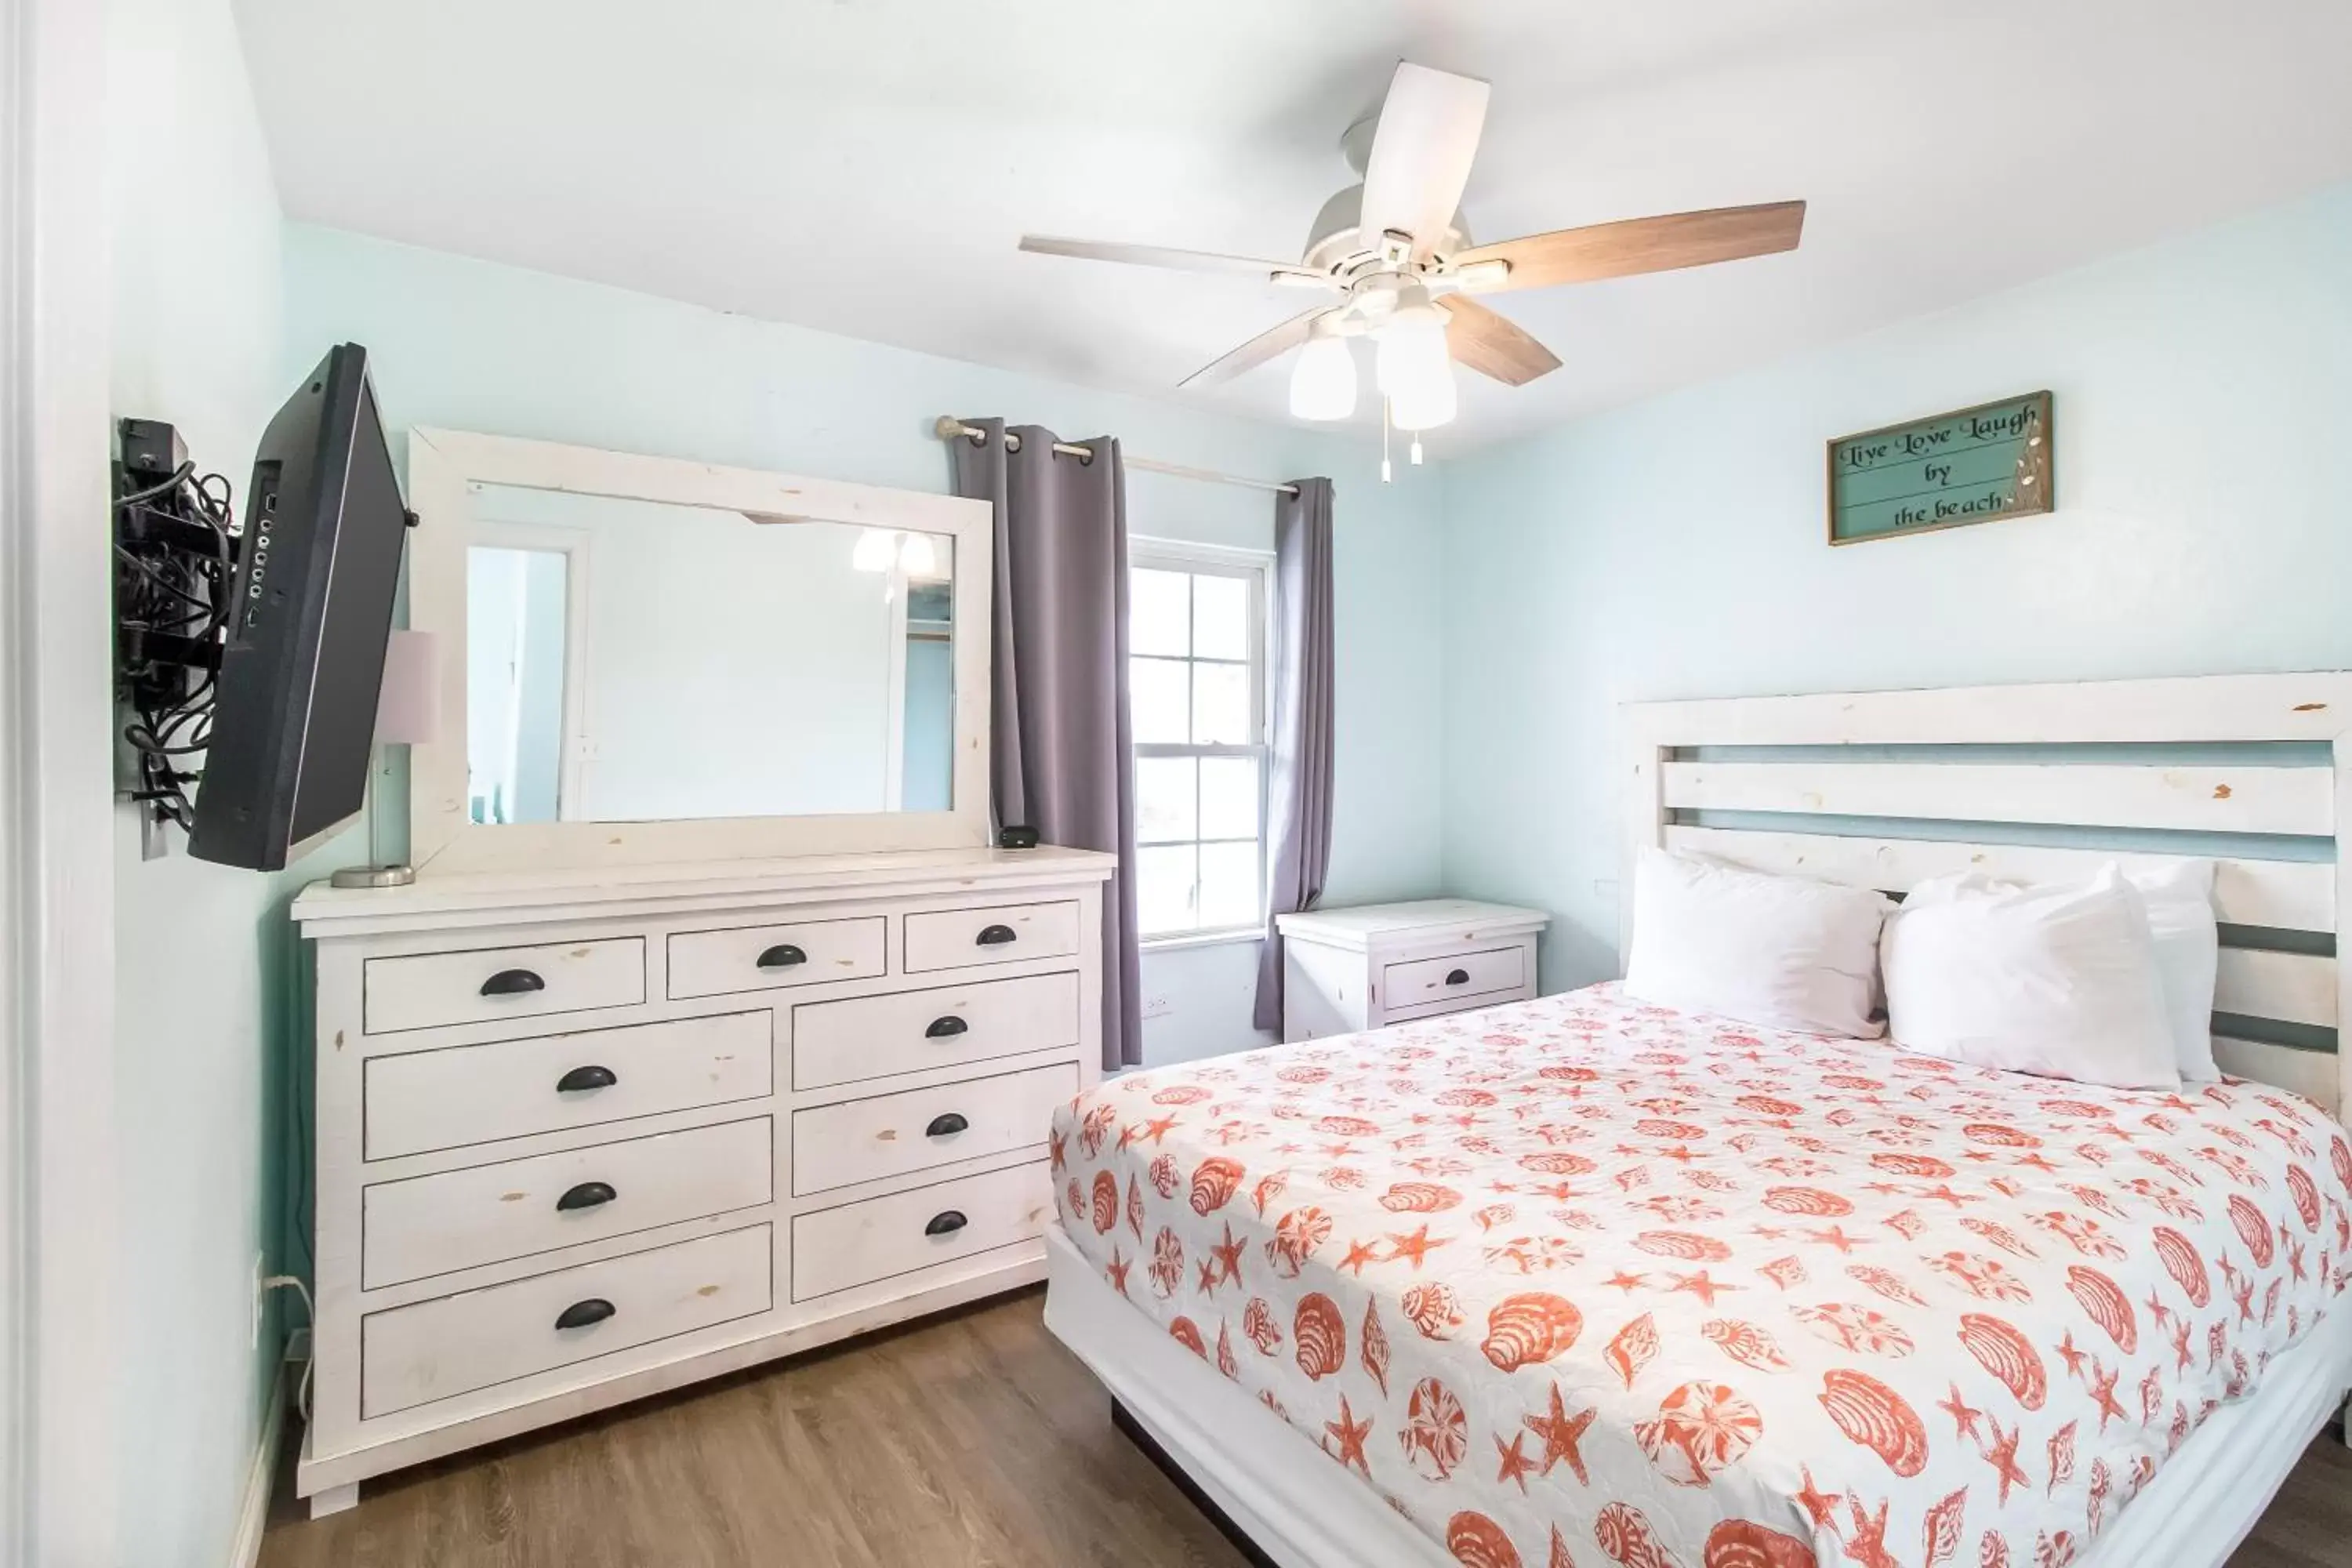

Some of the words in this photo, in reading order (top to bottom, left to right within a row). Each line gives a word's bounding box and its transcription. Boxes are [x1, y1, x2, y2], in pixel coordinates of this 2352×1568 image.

[1839, 445, 1887, 467] Live
[1894, 427, 1951, 456] Love
[1959, 405, 2036, 439] Laugh
[1925, 463, 1951, 486] by
[1894, 506, 1926, 526] the
[1933, 492, 2002, 523] beach
